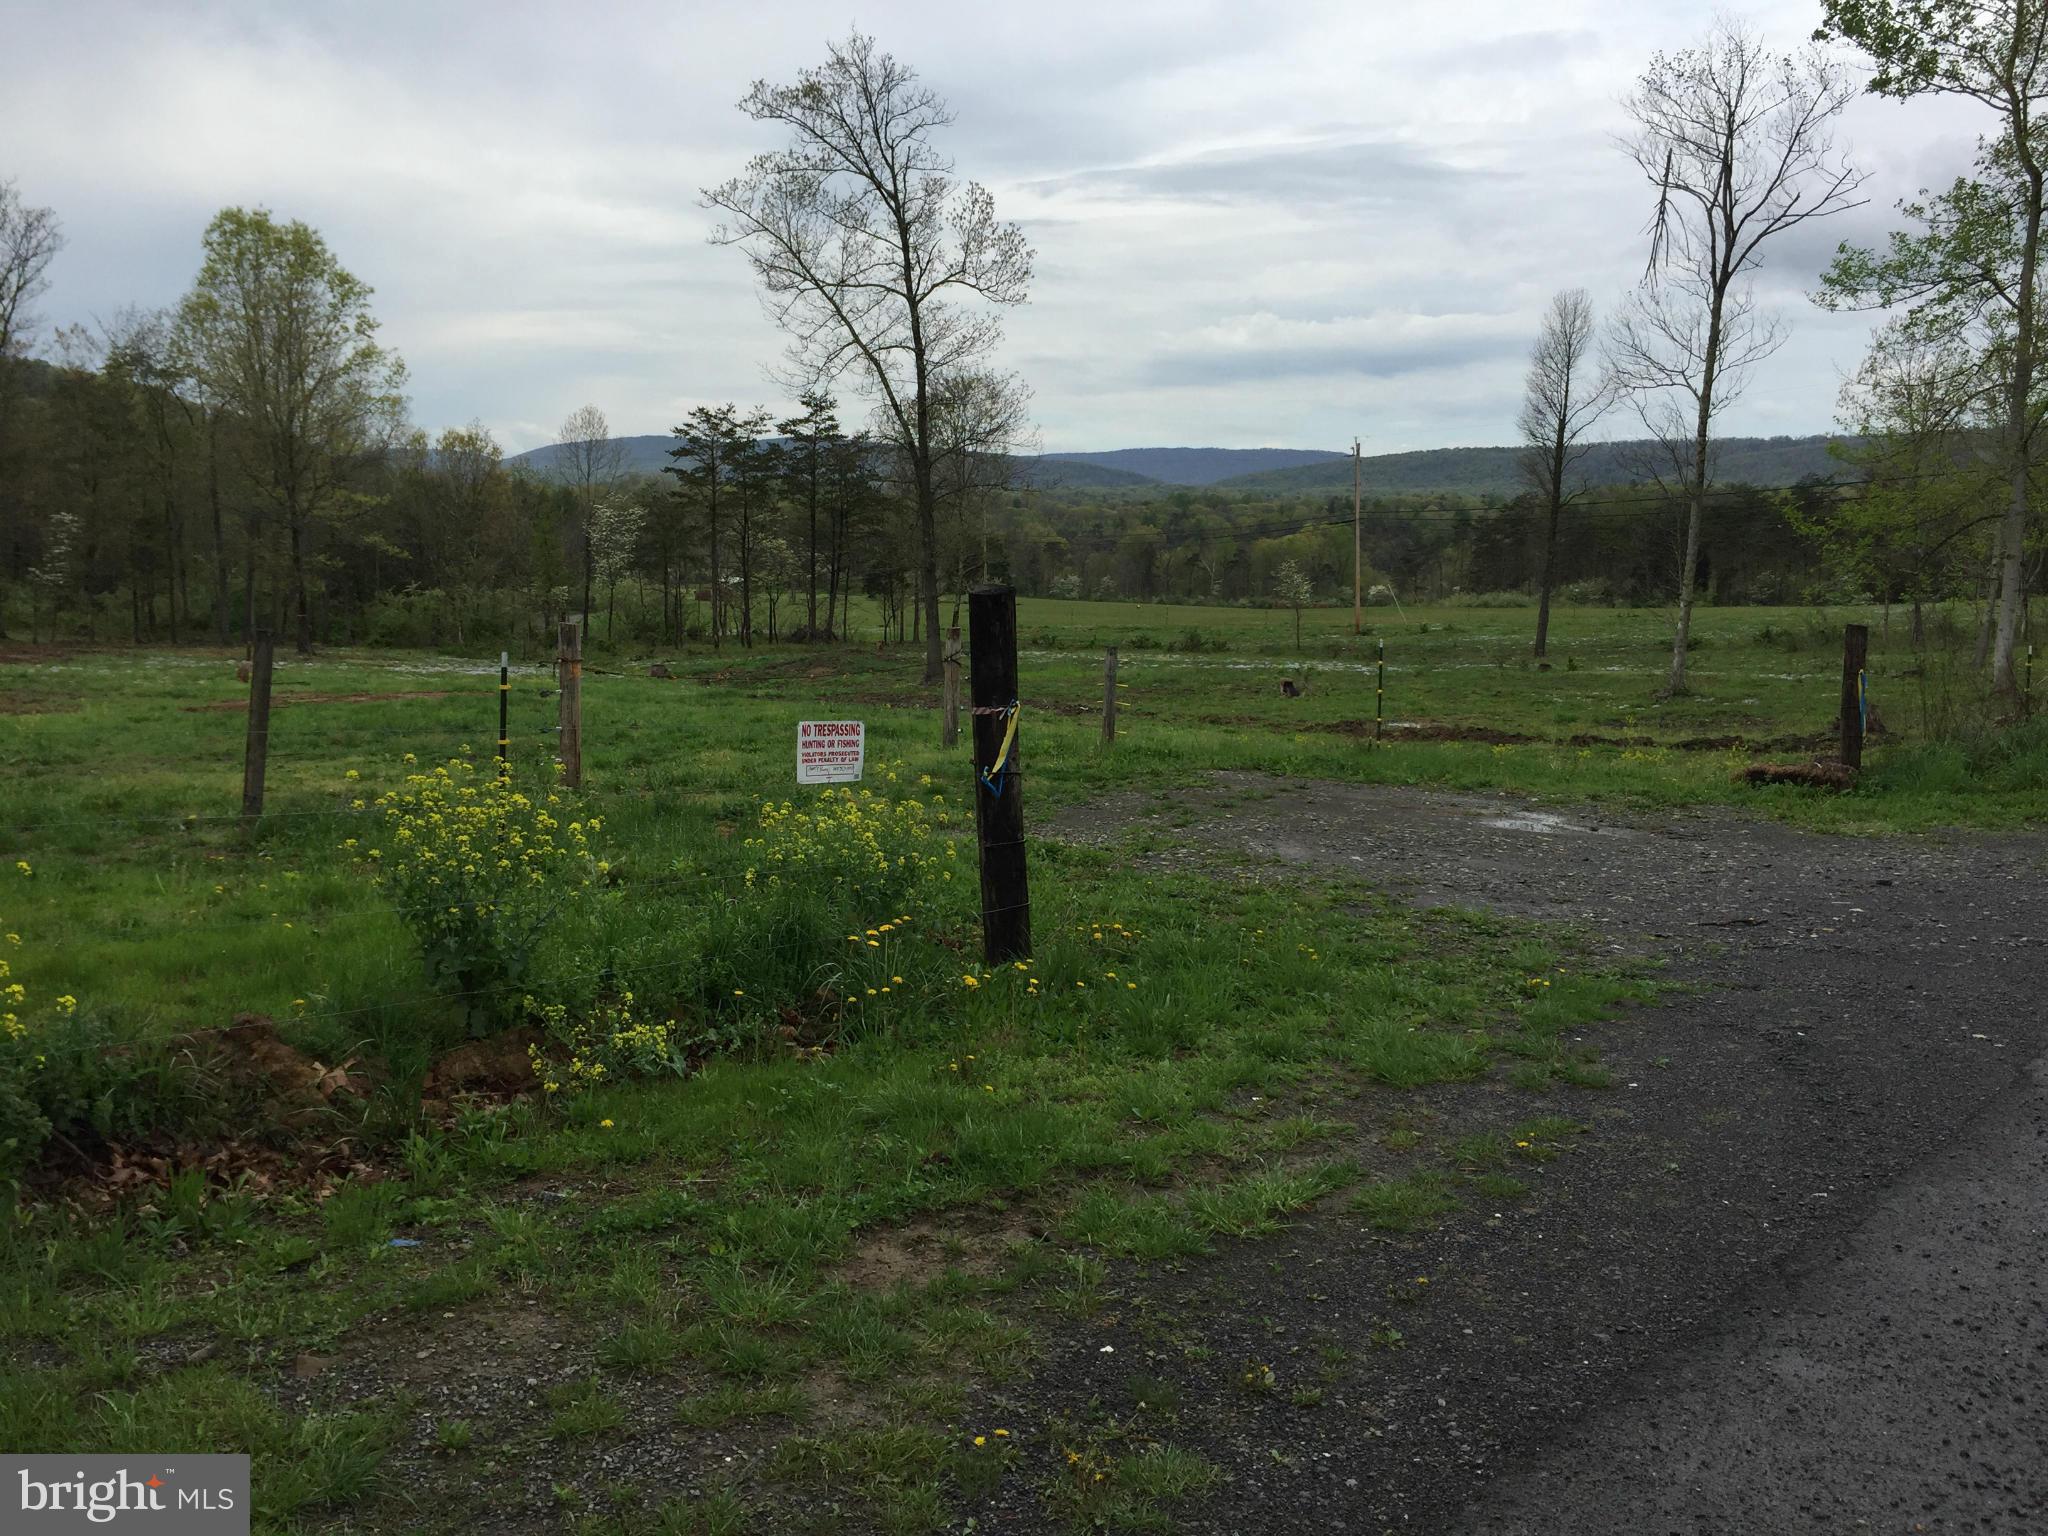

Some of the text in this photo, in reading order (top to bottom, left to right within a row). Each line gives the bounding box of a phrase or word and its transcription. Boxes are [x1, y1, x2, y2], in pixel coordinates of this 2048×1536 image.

[801, 723, 860, 737] NO TRESPASSING
[801, 739, 860, 749] HUNTING OR FISHING
